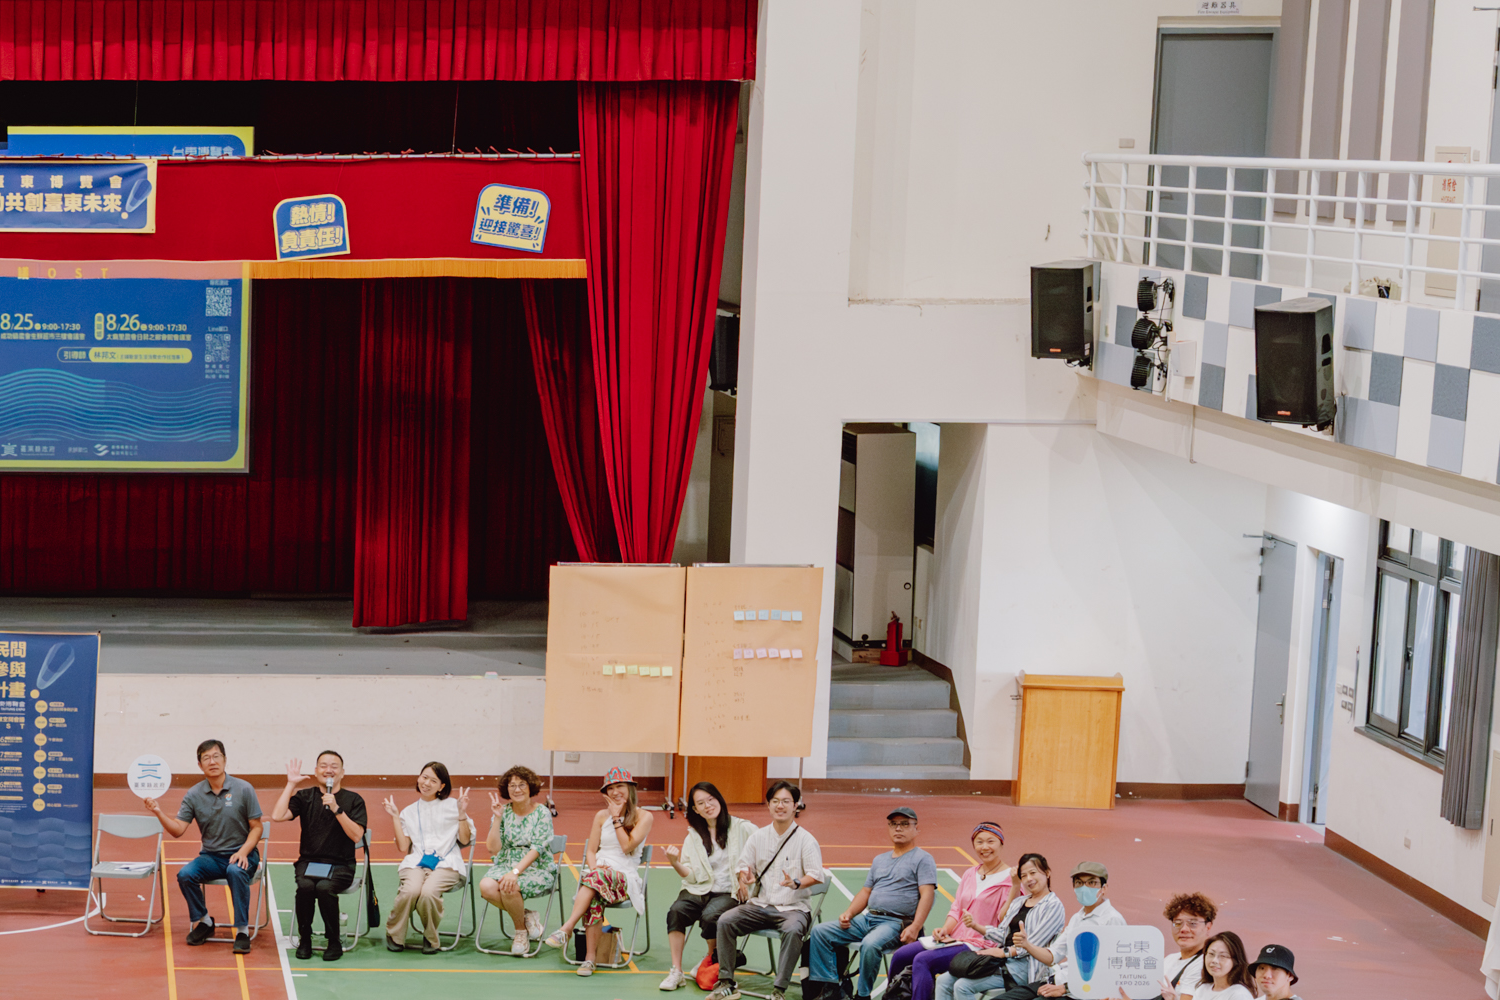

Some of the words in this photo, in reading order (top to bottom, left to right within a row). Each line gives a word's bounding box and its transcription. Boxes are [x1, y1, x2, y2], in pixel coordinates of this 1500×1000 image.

[0, 313, 34, 330] 8/25
[41, 323, 81, 331] 9:00-17:30
[106, 314, 140, 331] 8/26
[148, 323, 187, 331] 9:00-17:30
[1116, 940, 1150, 954] 台東
[1107, 955, 1157, 970] 博覽會
